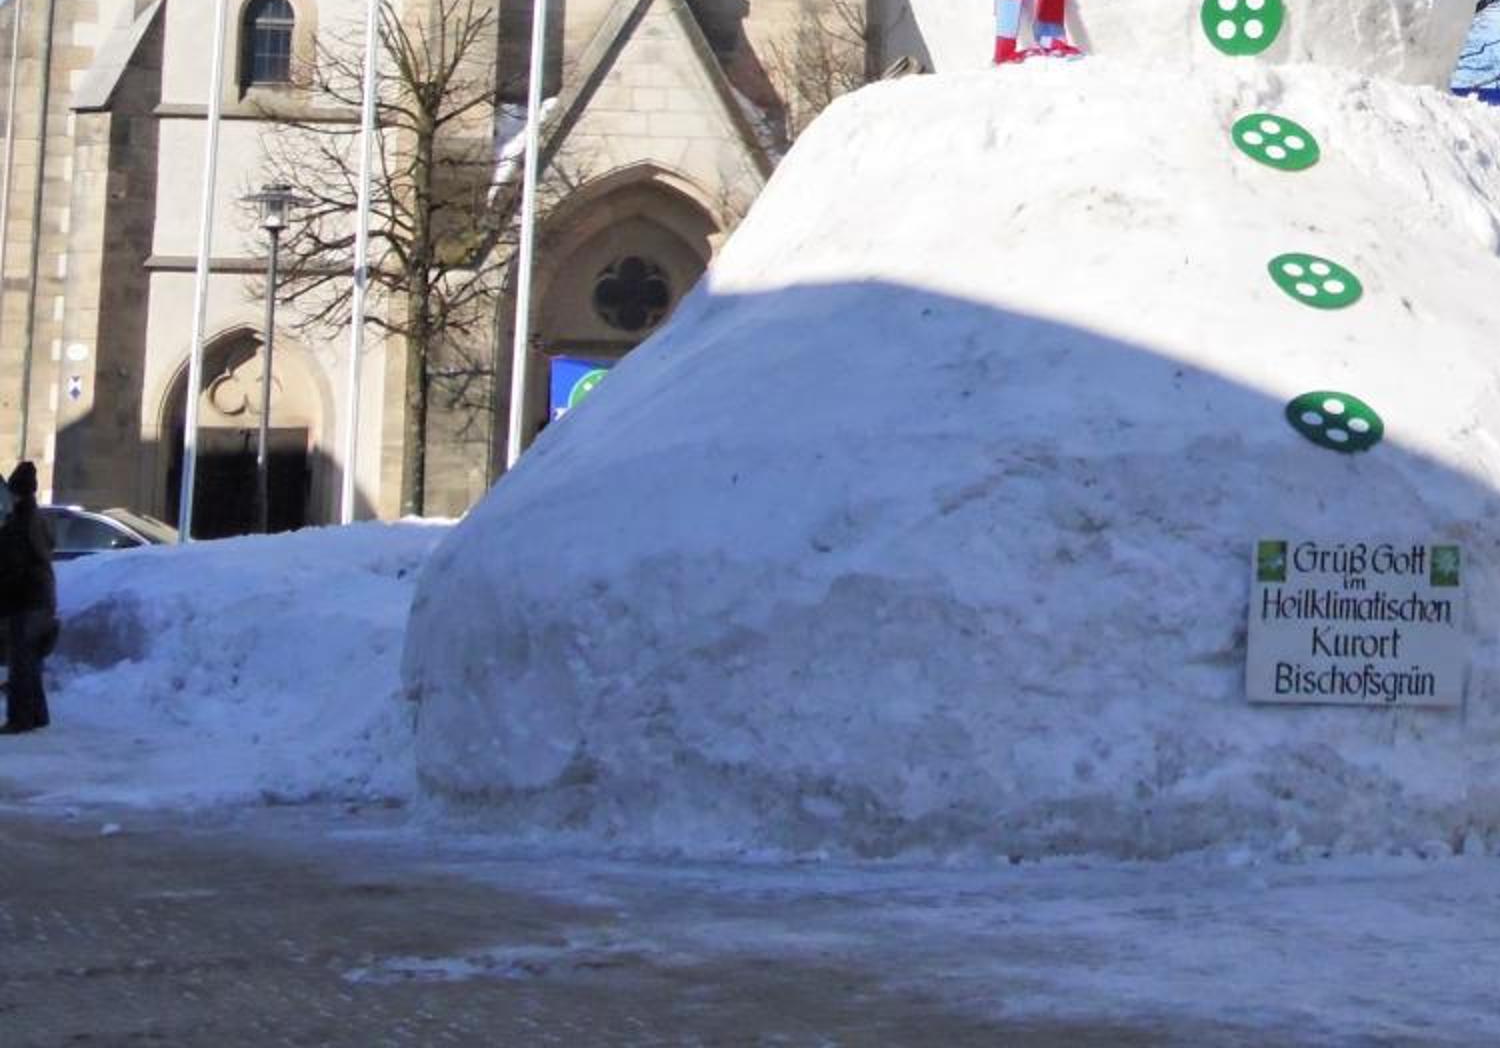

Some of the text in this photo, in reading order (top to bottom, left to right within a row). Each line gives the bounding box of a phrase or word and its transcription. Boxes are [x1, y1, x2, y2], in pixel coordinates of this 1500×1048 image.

[1293, 541, 1426, 575] Grüß Gott
[1343, 575, 1367, 591] im
[1261, 587, 1452, 623] Heilklimatischen
[1311, 626, 1401, 659] Kurort
[1274, 661, 1435, 703] Bischofsgrün
